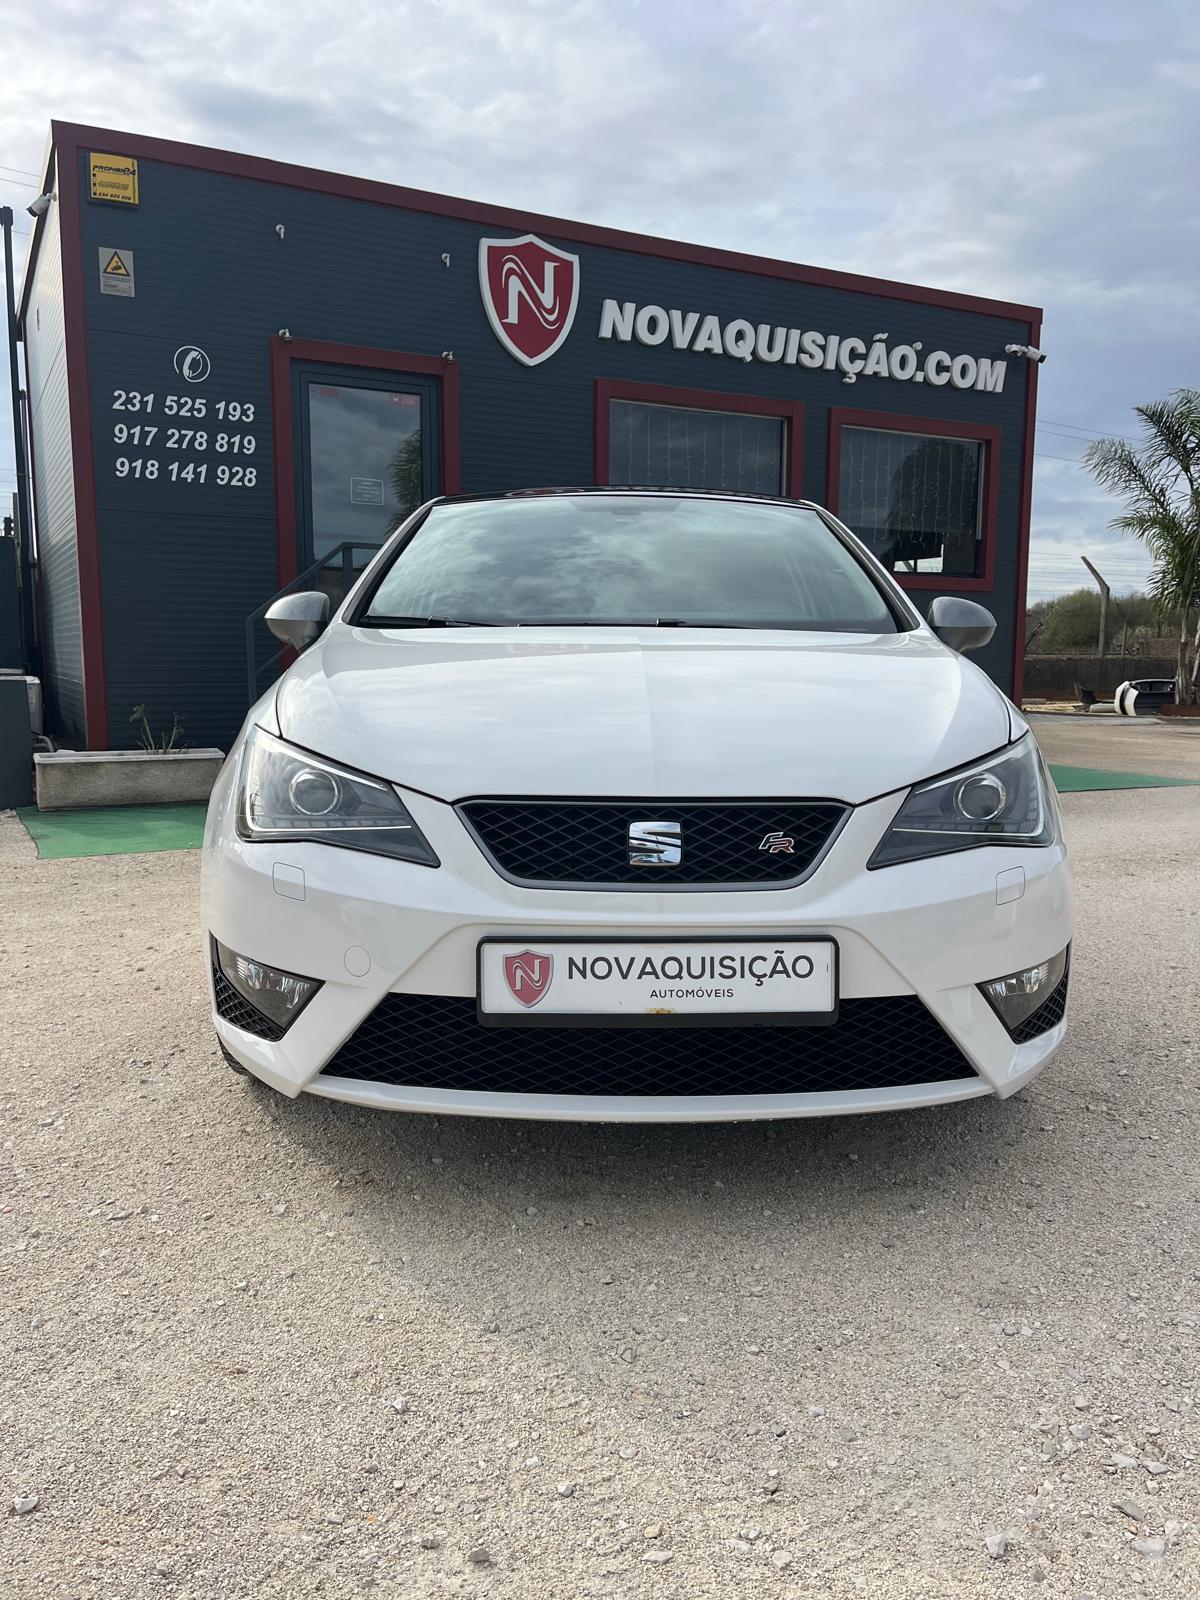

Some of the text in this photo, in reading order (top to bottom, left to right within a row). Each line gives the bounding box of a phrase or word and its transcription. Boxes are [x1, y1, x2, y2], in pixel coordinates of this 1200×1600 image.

[598, 299, 1007, 393] NOVAQUISIÇÃO.COM
[112, 390, 255, 423] 231 525 193
[113, 423, 256, 455] 917 278 819
[115, 457, 257, 487] 918 141 928
[758, 831, 795, 853] FR
[567, 950, 814, 986] NOVAQUISIÇÃO
[650, 987, 735, 999] AUTOMÓVEIS
